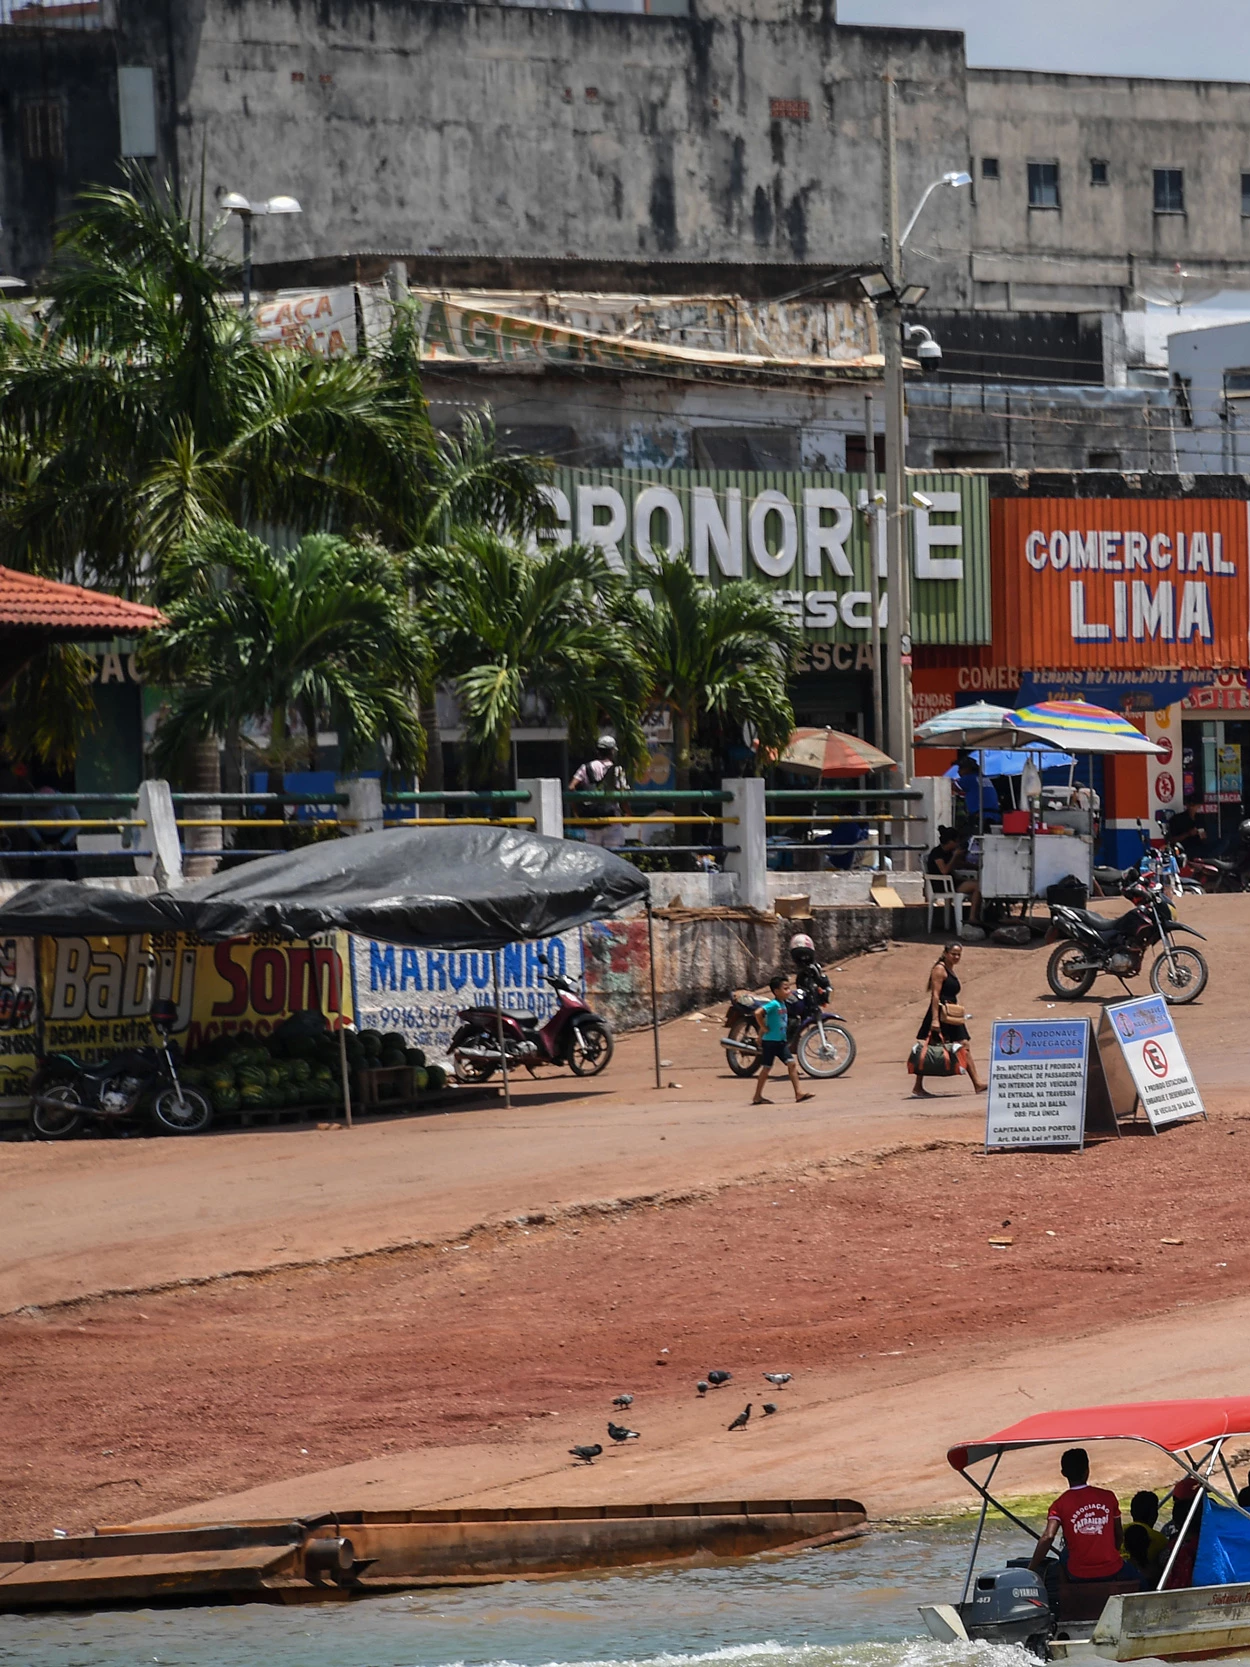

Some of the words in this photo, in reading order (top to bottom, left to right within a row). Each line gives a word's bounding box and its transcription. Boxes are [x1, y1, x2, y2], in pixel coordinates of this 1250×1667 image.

[1025, 530, 1237, 577] COMERCIAL
[1070, 580, 1214, 644] LIMA
[369, 937, 566, 995] MARQUINHO
[50, 934, 197, 1034] Baby
[211, 935, 344, 1017] Som
[1031, 1030, 1078, 1038] RODONAVE
[1008, 1063, 1044, 1071] MOTORISTAS
[1050, 1062, 1076, 1070] PROIBIDO
[1048, 1124, 1076, 1132] PORTOS
[976, 1596, 991, 1604] 40
[1019, 1588, 1039, 1597] YAMAHA
